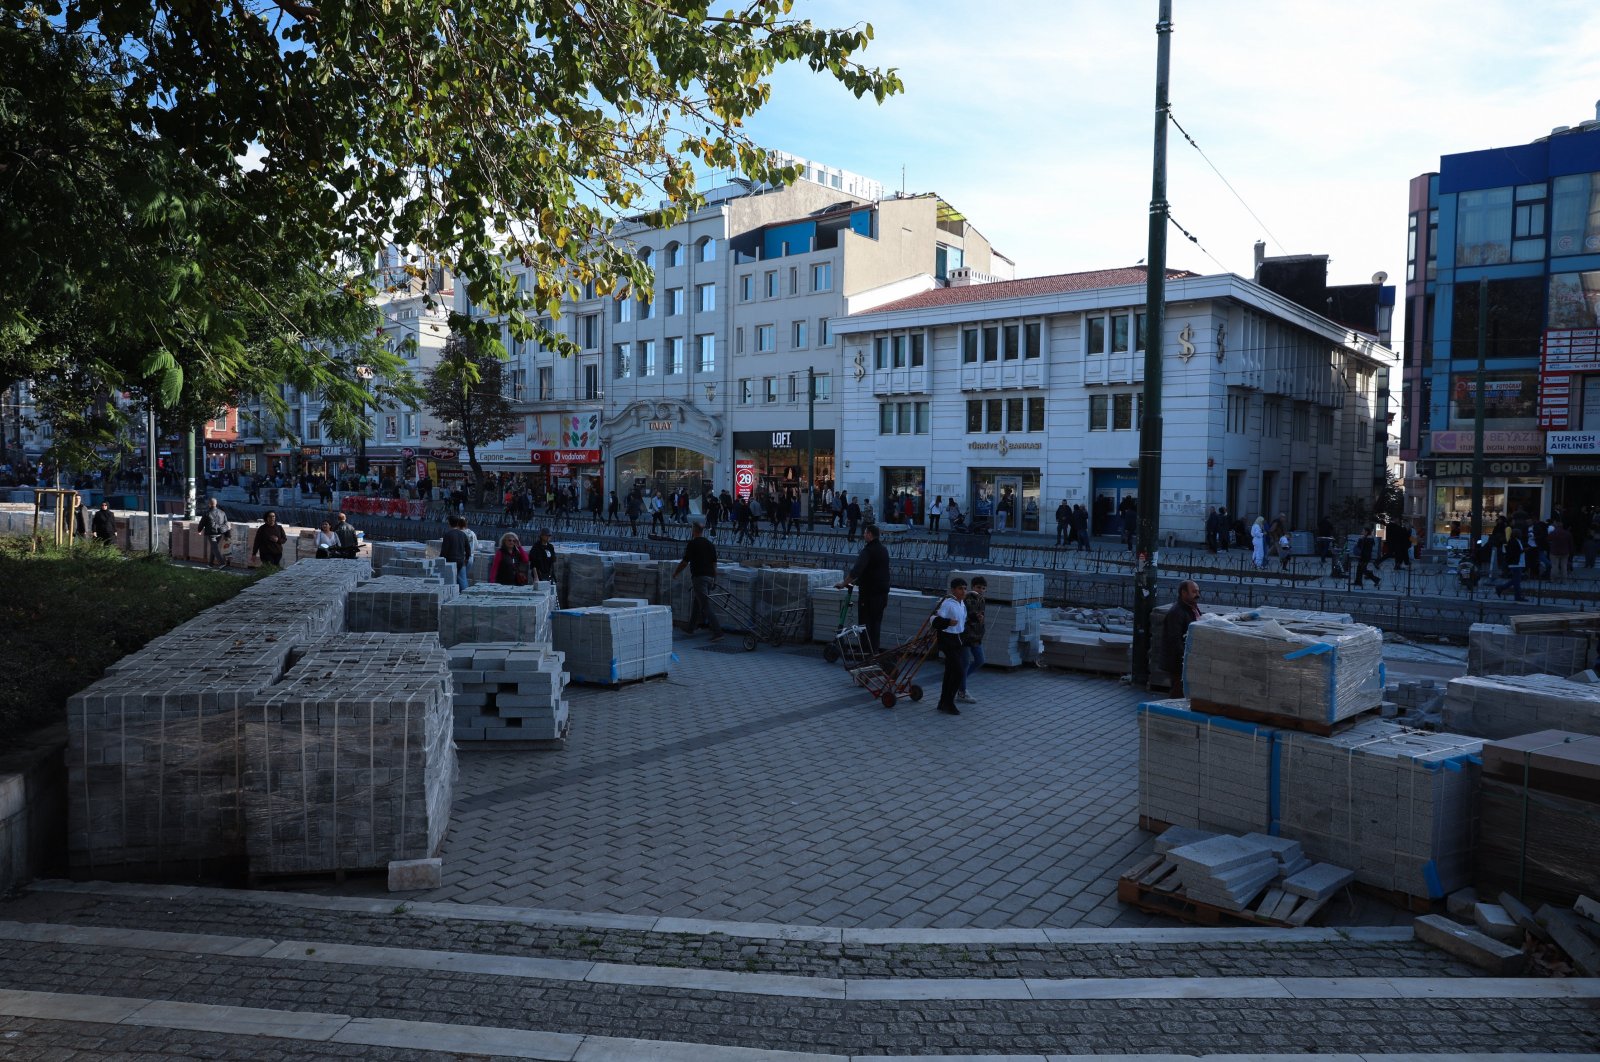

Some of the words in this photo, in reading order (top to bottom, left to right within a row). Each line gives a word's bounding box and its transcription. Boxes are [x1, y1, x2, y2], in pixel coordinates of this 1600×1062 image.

[479, 452, 504, 461] Capone
[561, 452, 586, 460] vodafone
[1435, 461, 1475, 476] EMR
[1490, 462, 1531, 473] GOLD
